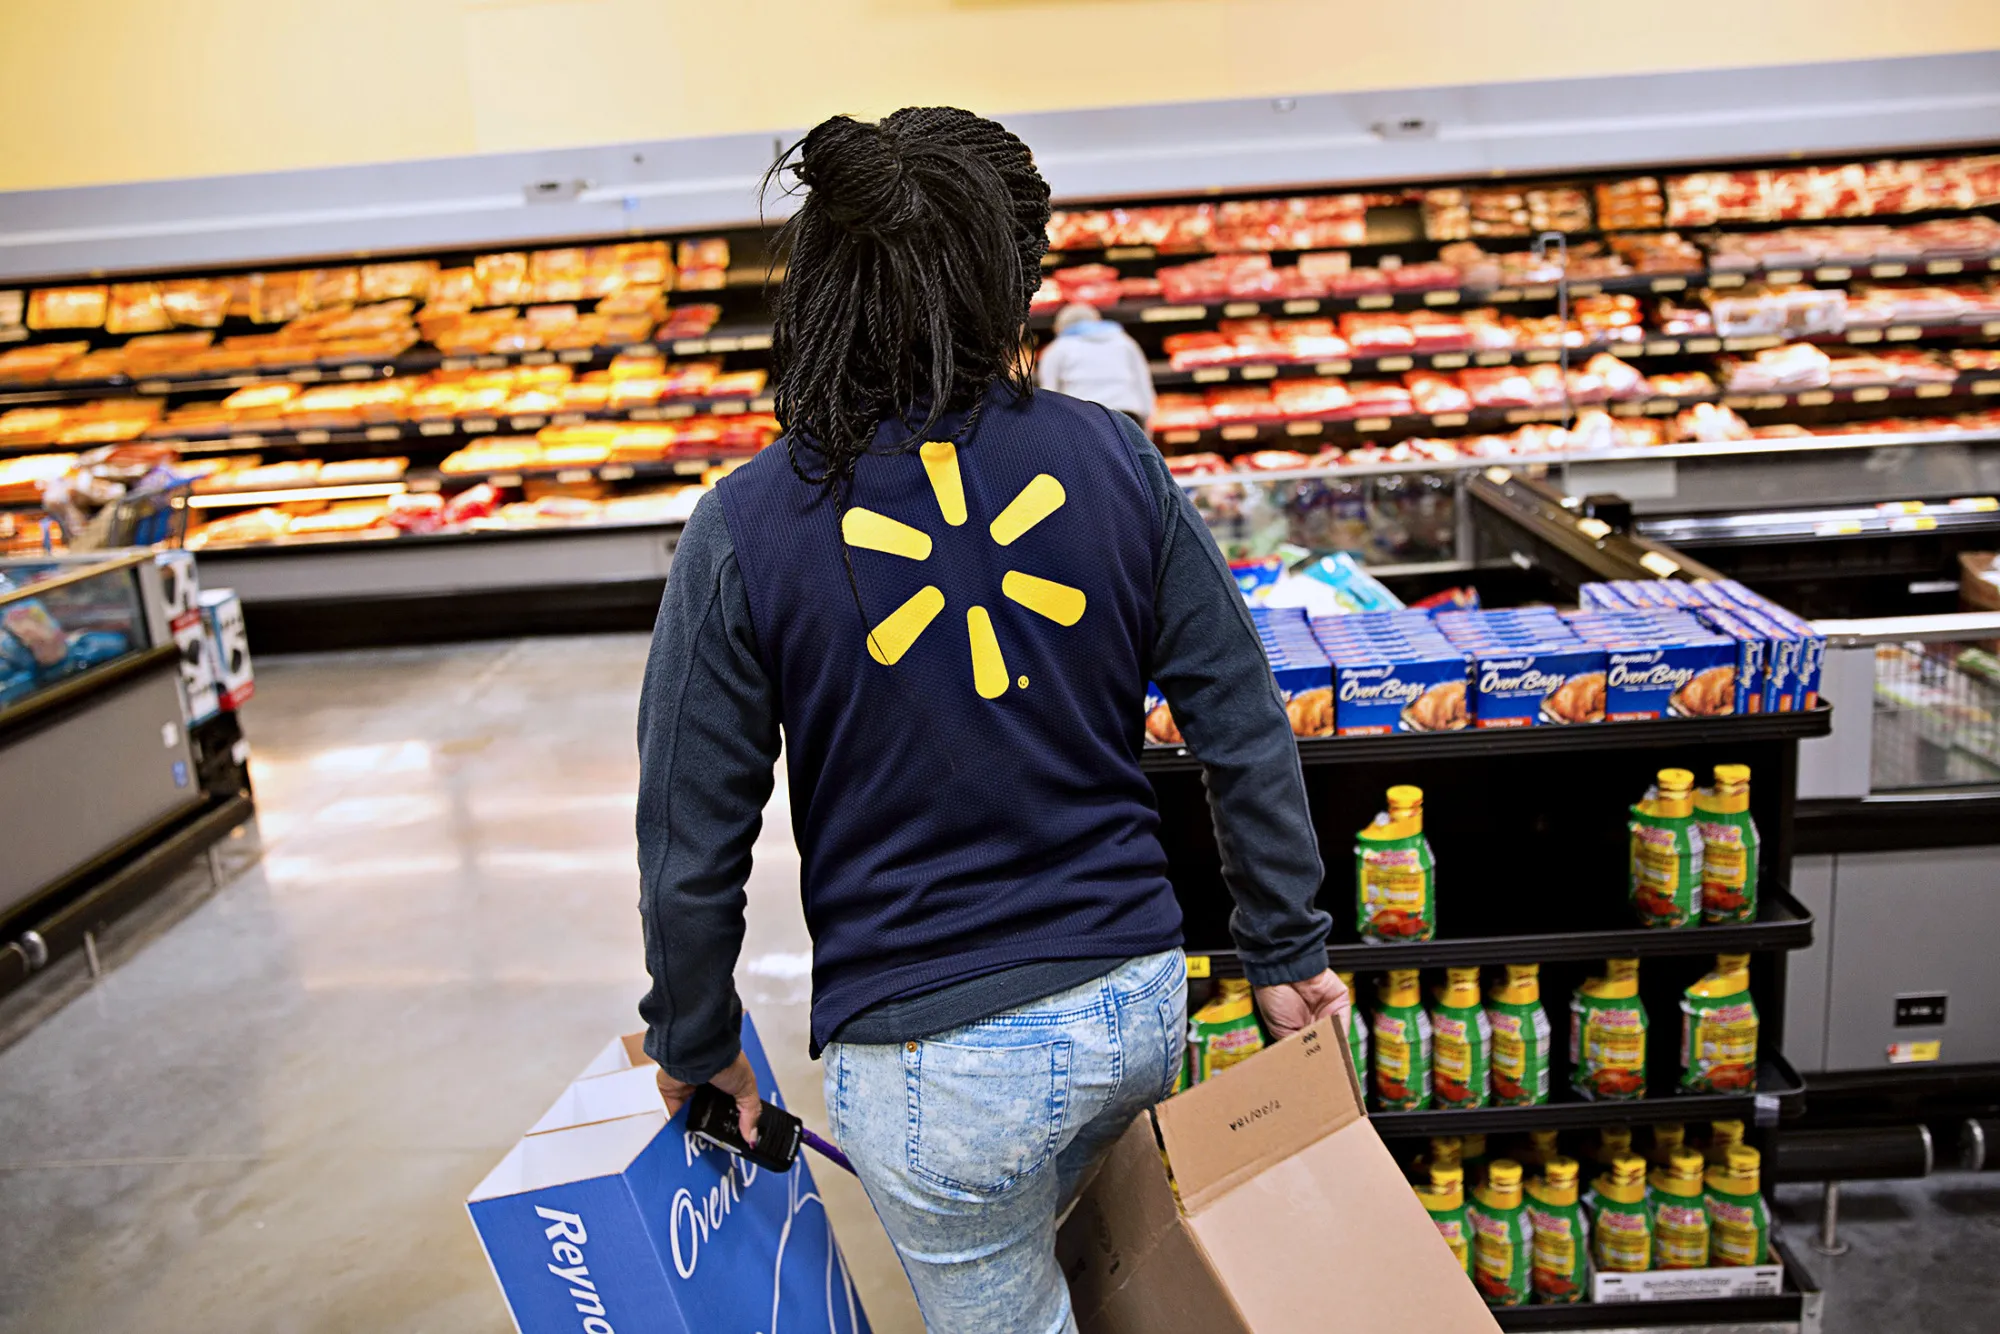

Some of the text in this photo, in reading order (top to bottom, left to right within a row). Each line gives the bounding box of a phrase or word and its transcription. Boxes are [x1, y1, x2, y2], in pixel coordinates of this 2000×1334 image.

[1480, 670, 1565, 694] Oven Bags
[1608, 664, 1694, 689] Oven Bags
[1340, 678, 1425, 703] Oven Bags
[670, 1165, 741, 1280] Oven
